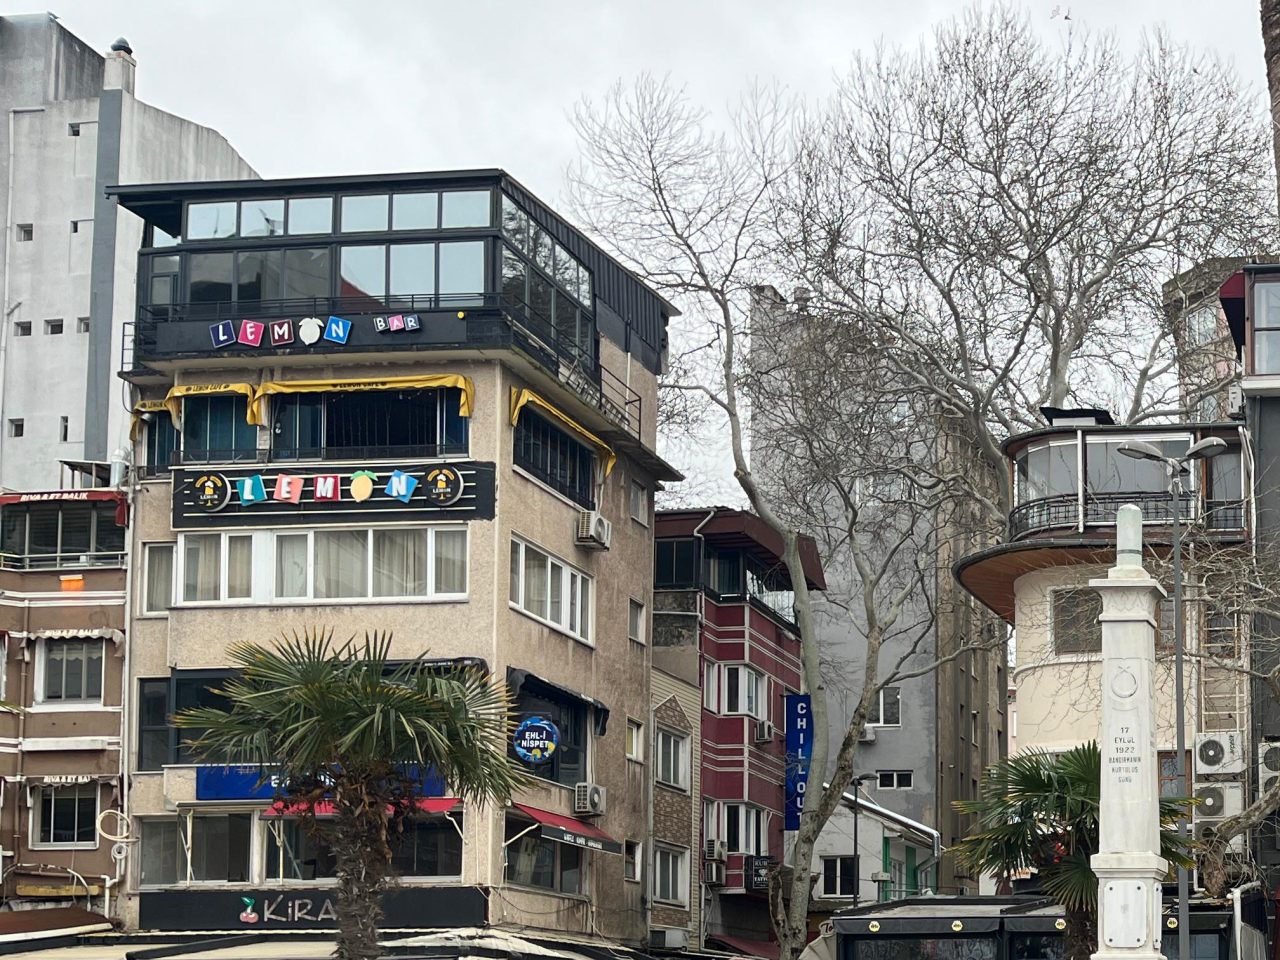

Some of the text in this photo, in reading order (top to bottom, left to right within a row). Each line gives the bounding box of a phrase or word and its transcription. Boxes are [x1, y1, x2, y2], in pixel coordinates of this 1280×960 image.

[374, 315, 420, 331] BAR
[796, 702, 808, 775] CHILL
[1115, 746, 1135, 754] 1922
